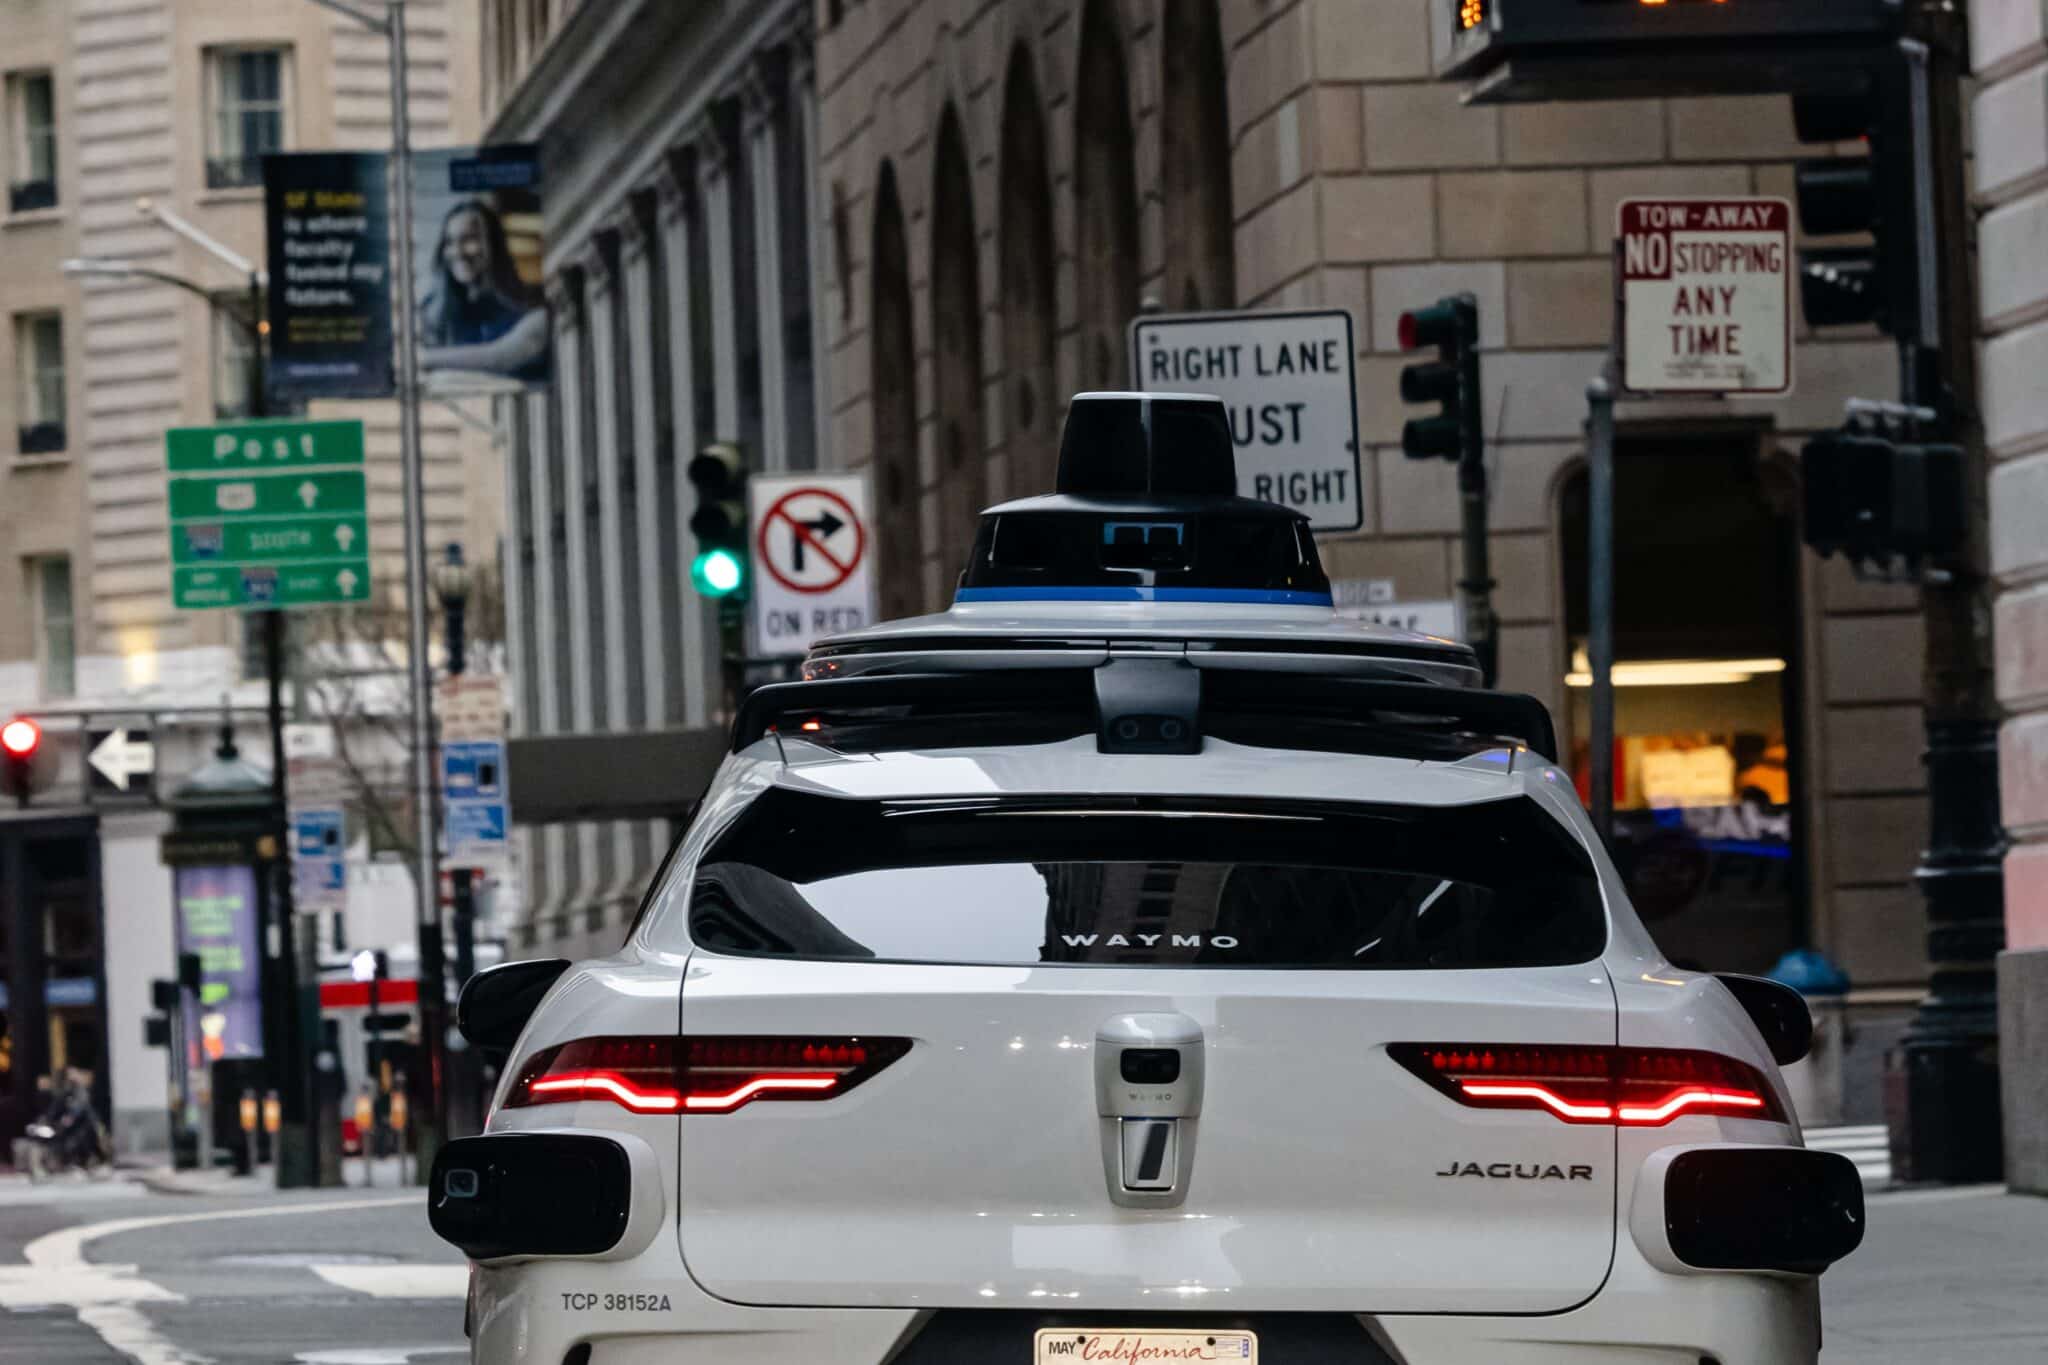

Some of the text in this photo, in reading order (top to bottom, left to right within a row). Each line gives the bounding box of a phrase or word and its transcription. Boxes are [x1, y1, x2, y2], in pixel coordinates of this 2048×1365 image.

[1637, 205, 1773, 228] TOW-AWAY
[1625, 232, 1781, 275] NO STOPPING
[1673, 286, 1737, 315] ANY
[1668, 324, 1741, 355] TIME
[1151, 340, 1340, 381] RIGHT LANE
[1229, 402, 1306, 446] UST
[213, 432, 314, 461] Post
[1255, 469, 1347, 505] RIGHT
[766, 606, 862, 637] ON RED
[1061, 934, 1240, 949] WAYMO
[1436, 1161, 1593, 1181] JAGUAR
[561, 1293, 672, 1312] TCP 38152A
[1049, 1341, 1077, 1355] MAY
[1082, 1336, 1216, 1365] California
